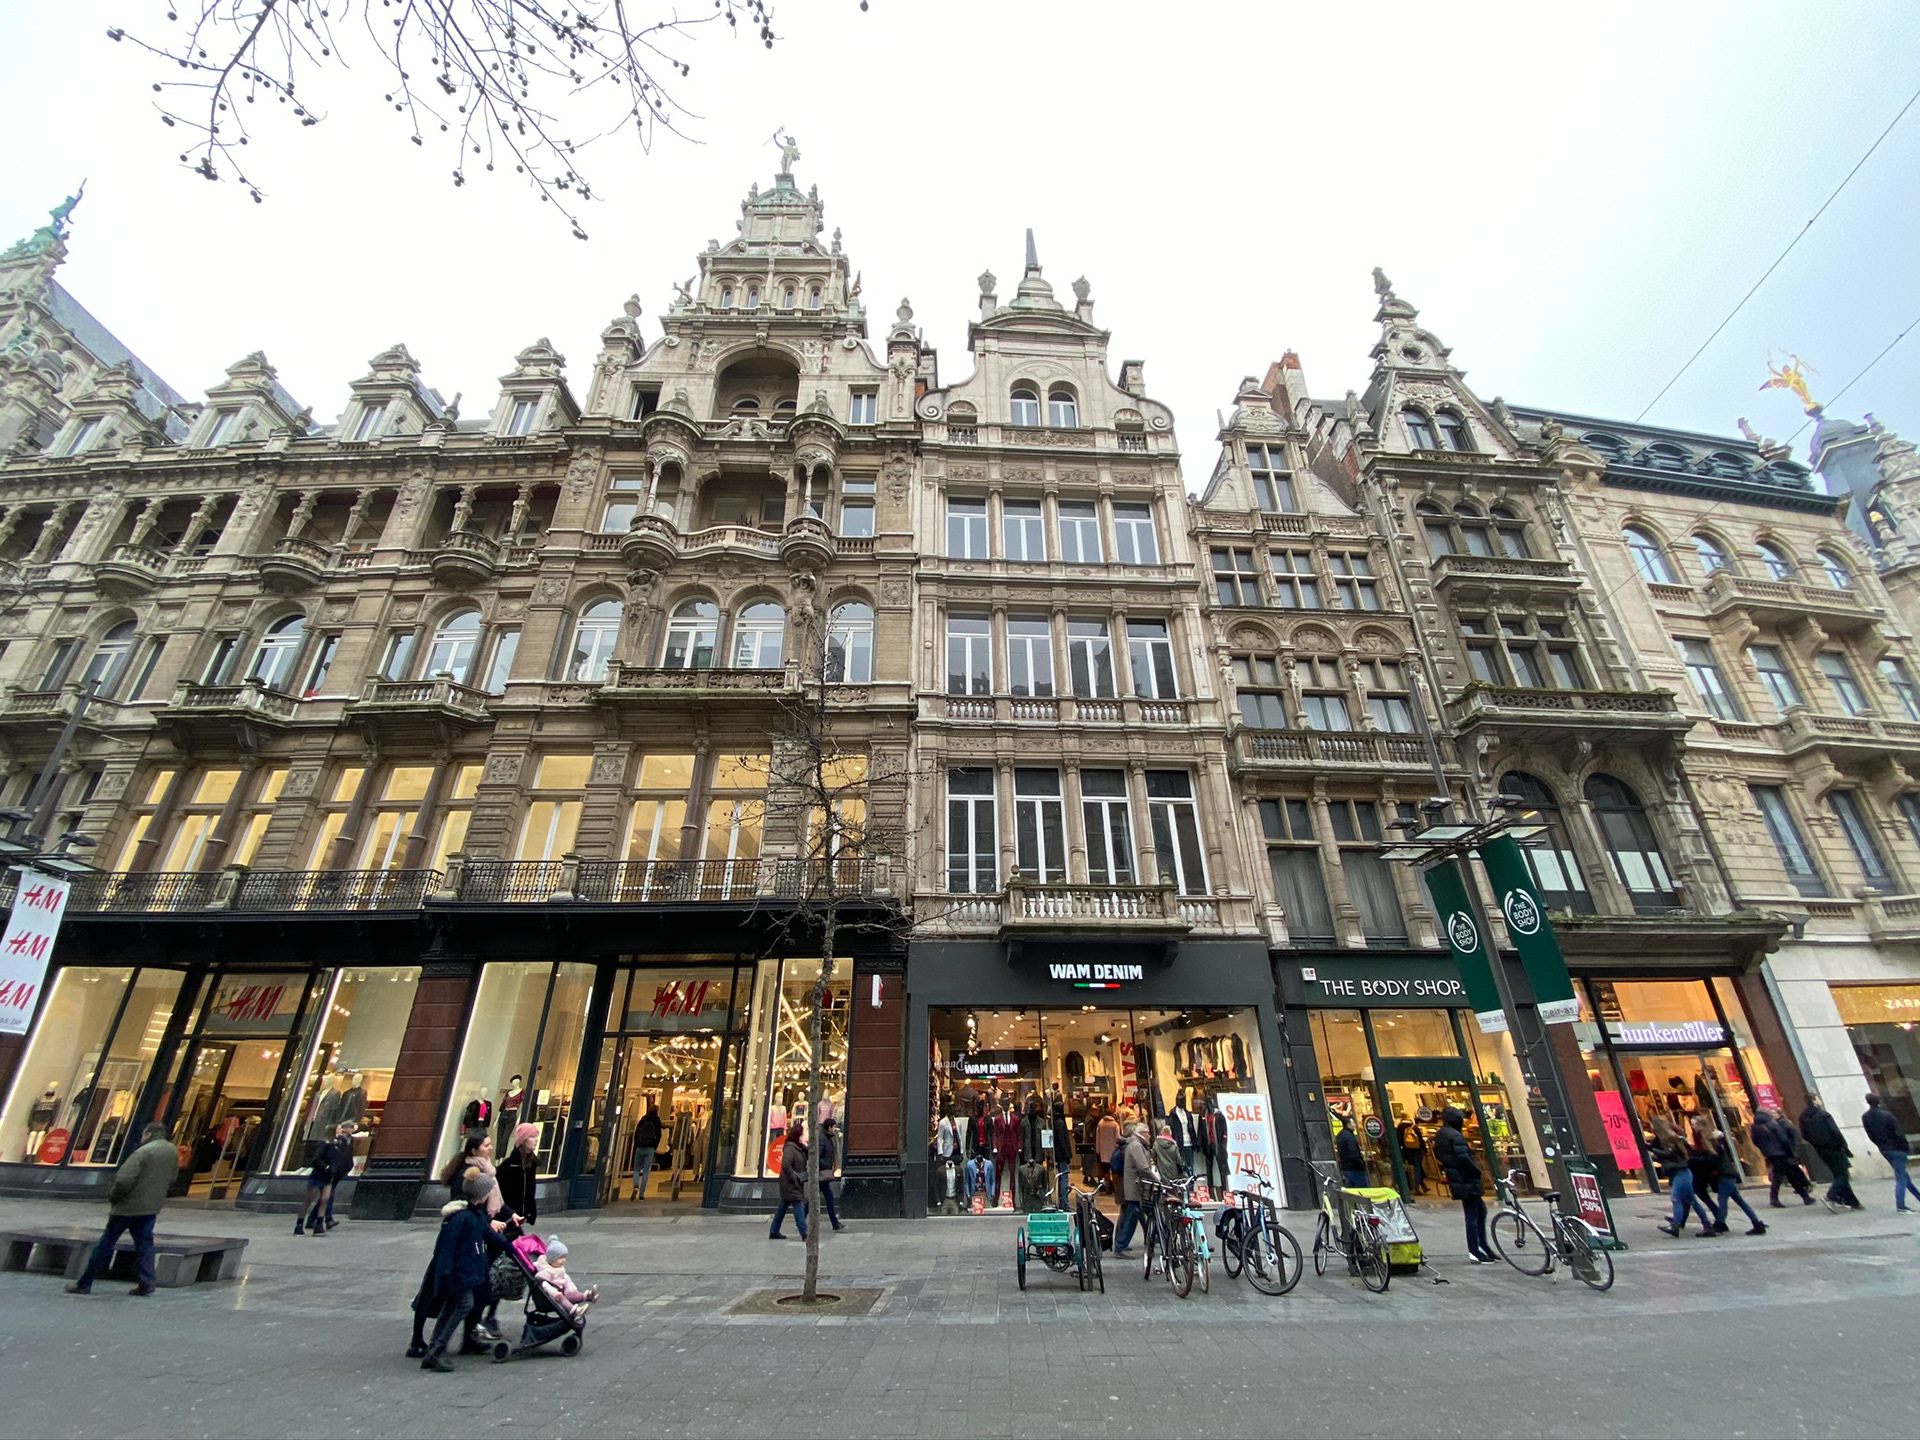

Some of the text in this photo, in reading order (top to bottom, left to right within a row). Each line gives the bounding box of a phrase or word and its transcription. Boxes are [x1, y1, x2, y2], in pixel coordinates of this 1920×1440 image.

[21, 883, 63, 914] H&M
[1514, 902, 1527, 910] THE
[1513, 908, 1533, 920] BODY
[1517, 917, 1535, 928] SHOP
[1455, 929, 1471, 940] BODY
[1459, 936, 1474, 947] SHOP
[5, 930, 50, 960] H&M
[1049, 964, 1143, 980] WAM DENIM
[1320, 980, 1356, 996] THE
[1361, 980, 1410, 996] BODY
[224, 986, 286, 1021] H&M
[651, 980, 709, 1018] H&M
[1617, 1021, 1724, 1042] hunkemöller
[964, 1063, 1018, 1074] WAM DENIM
[1225, 1104, 1262, 1122] SALE
[1235, 1131, 1259, 1143] up to
[1231, 1152, 1270, 1177] 70%
[1578, 1188, 1599, 1201] SALE
